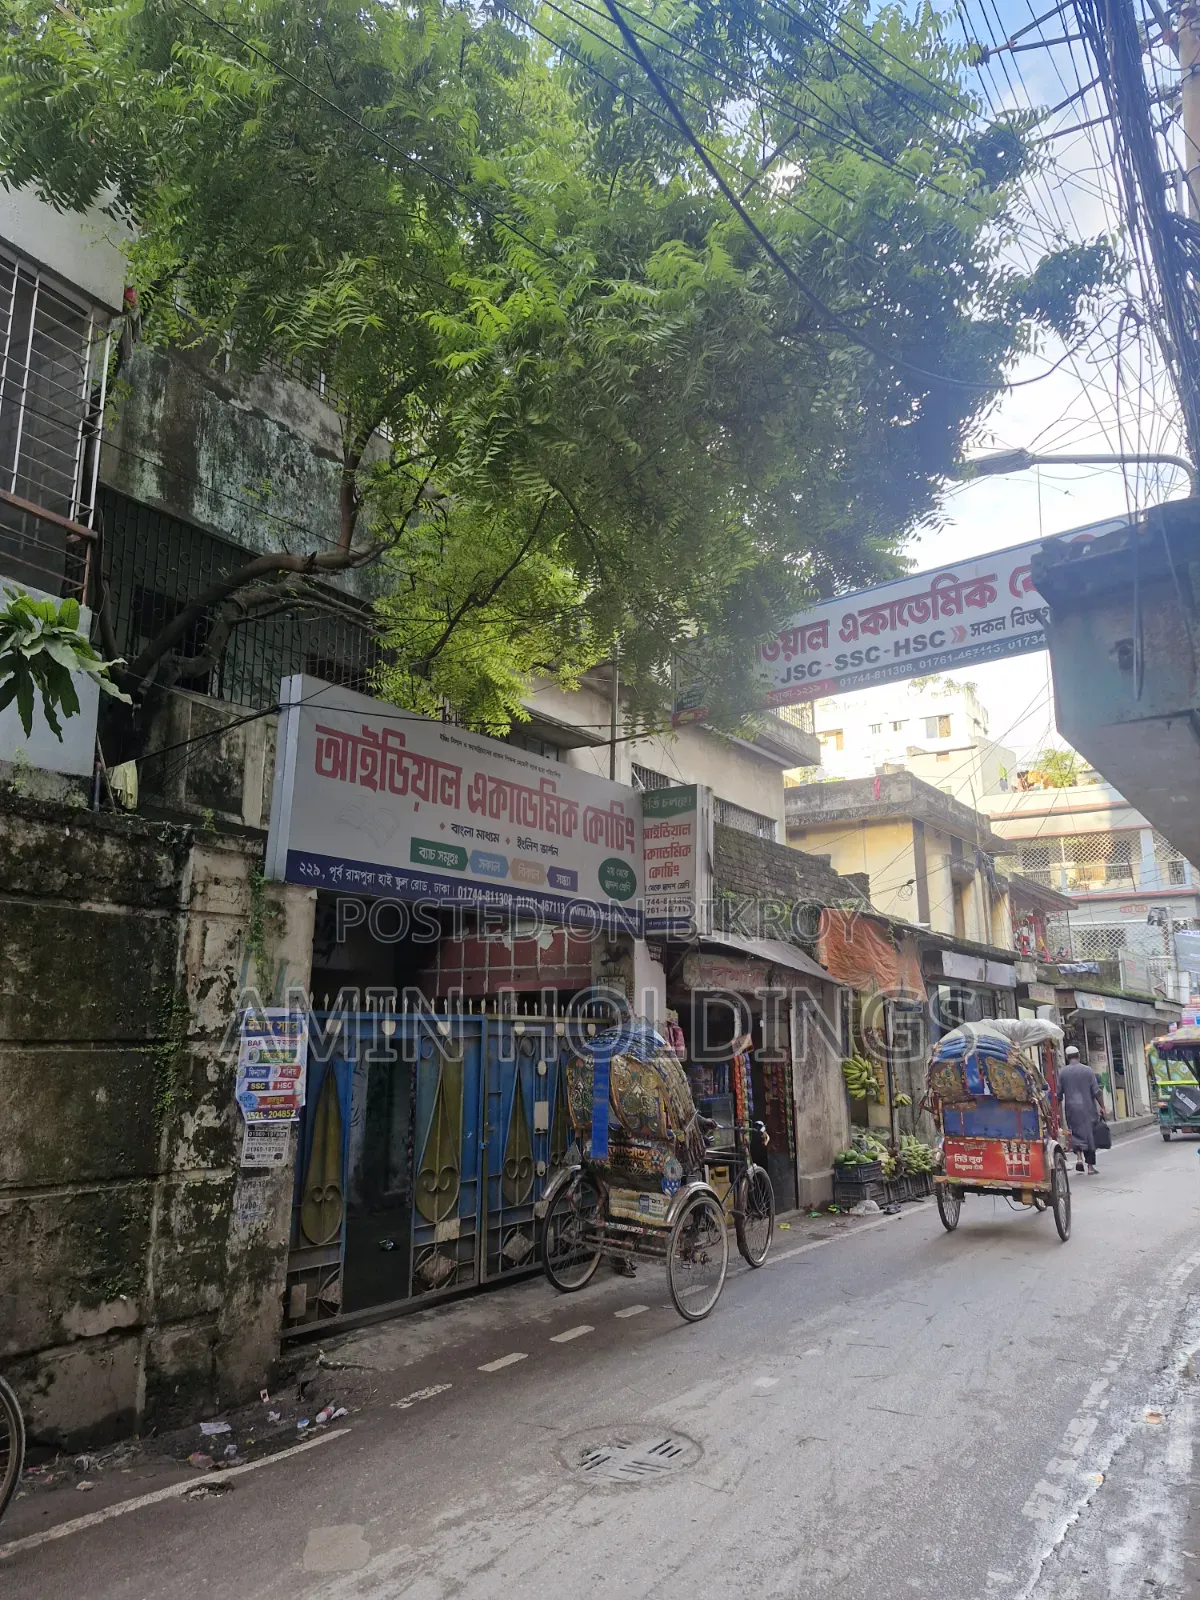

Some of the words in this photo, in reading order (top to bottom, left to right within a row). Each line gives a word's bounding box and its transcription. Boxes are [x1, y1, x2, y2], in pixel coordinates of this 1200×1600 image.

[839, 572, 998, 642] একাডেমিক
[969, 616, 1006, 638] সকল
[315, 723, 463, 812] আইডিয়াল
[467, 772, 579, 838] একাডেমিক
[582, 800, 635, 854] কোচিং
[450, 822, 474, 838] বাংলা
[476, 828, 500, 844] মাধ্যম
[516, 836, 539, 852] ইংলিশ
[644, 842, 692, 860] কাডেমিক
[419, 846, 436, 862] ব্যাচ
[478, 857, 501, 873] সকাল
[649, 861, 680, 878] কোচিং
[329, 864, 345, 883] পূর্ব
[345, 869, 375, 885] রামপুরা
[378, 872, 392, 888] হাই
[250, 1082, 266, 1090] SSC
